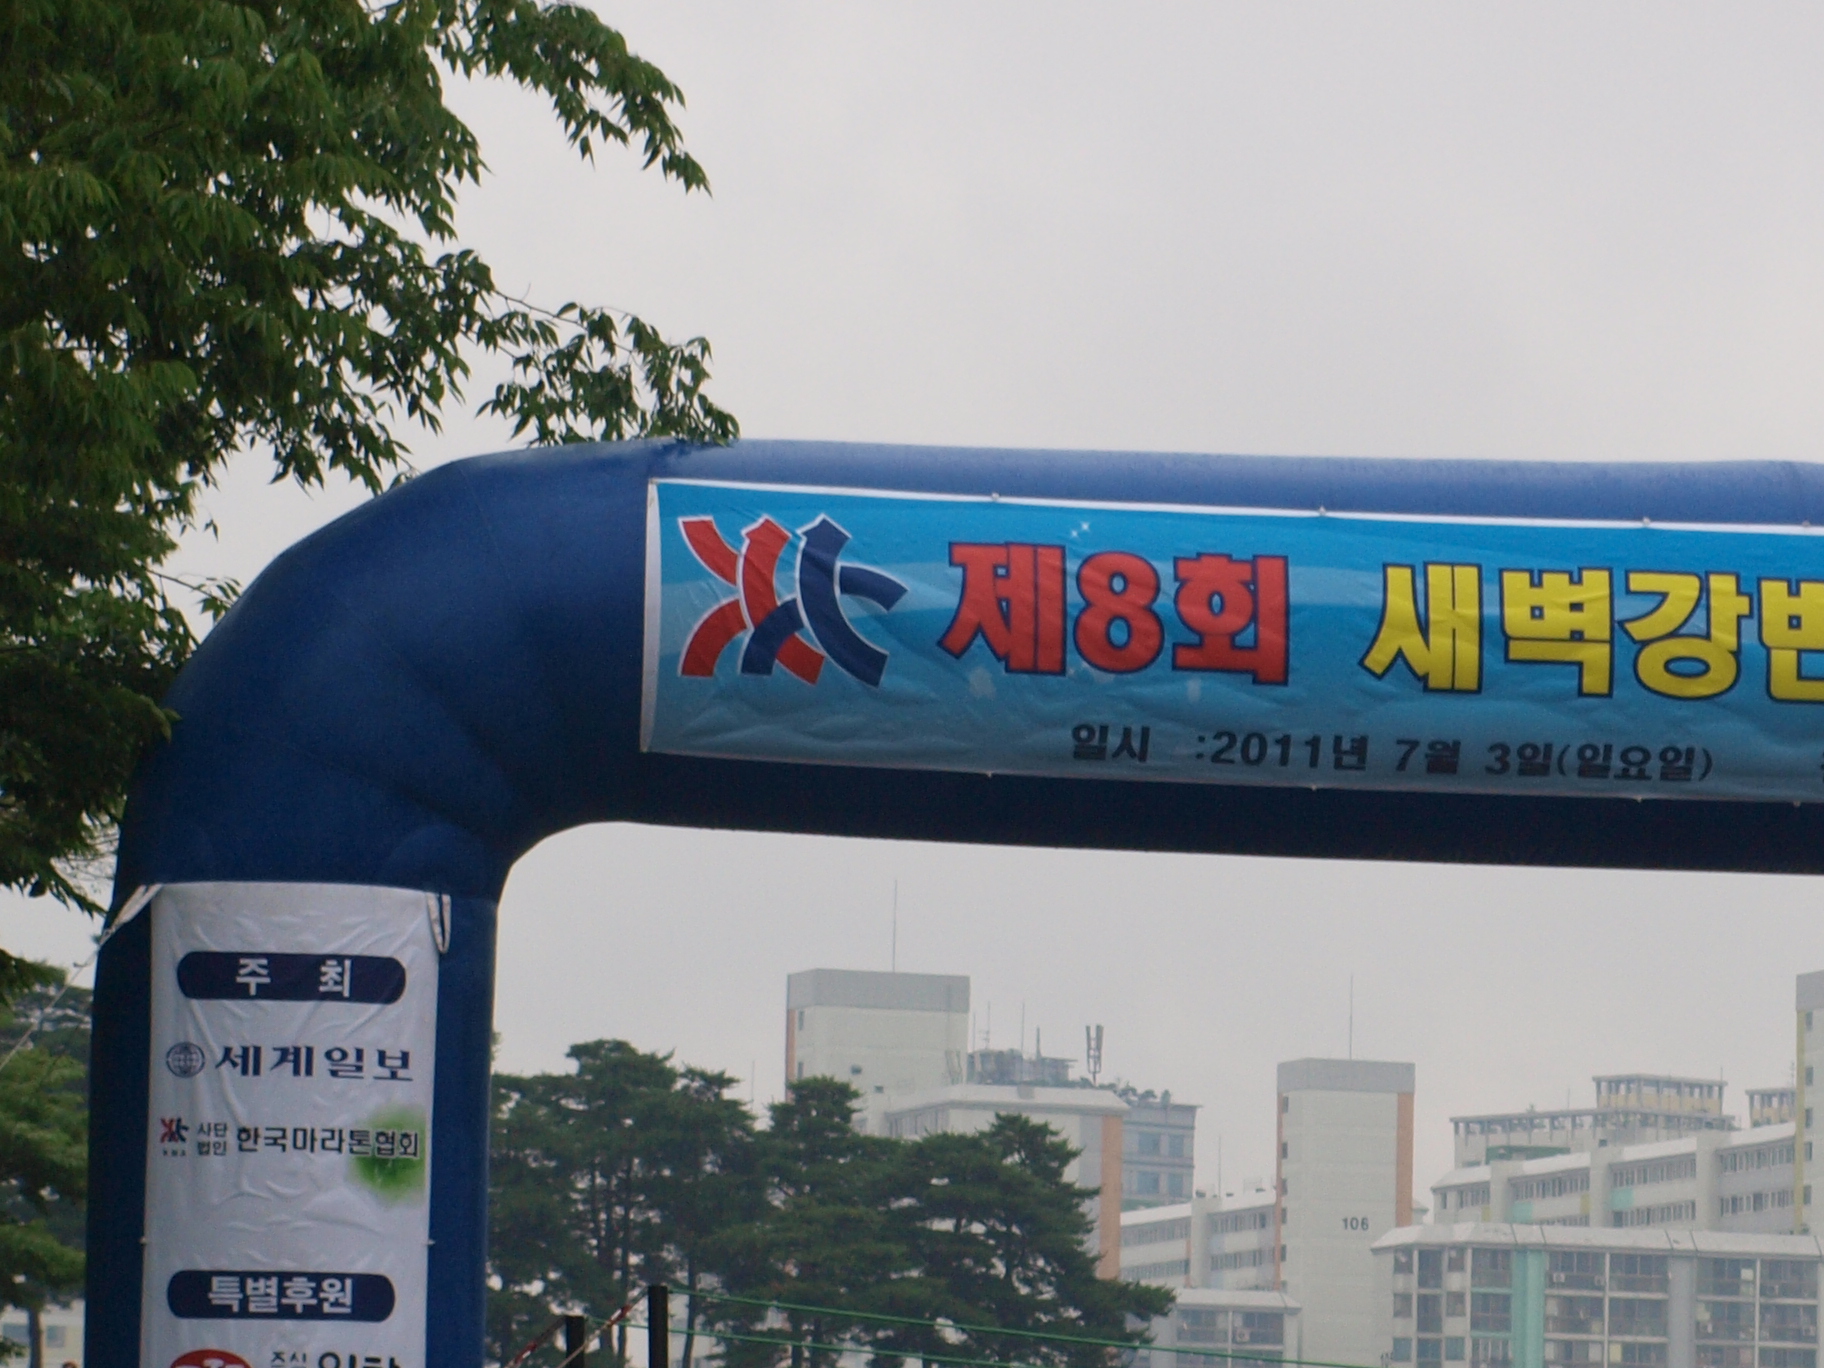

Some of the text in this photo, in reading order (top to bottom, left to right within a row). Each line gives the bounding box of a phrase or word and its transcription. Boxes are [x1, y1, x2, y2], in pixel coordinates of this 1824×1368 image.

[937, 541, 1290, 686] 제8회
[1071, 723, 1151, 763] 일시
[1395, 739, 1462, 775] 7월
[1485, 742, 1714, 782] 3일(일요일)
[215, 1045, 414, 1082] 세계일보
[197, 1122, 228, 1138] 사단
[236, 1126, 420, 1158] 한국마라톤협회
[1342, 1217, 1369, 1231] 106
[207, 1276, 353, 1315] 특별후원
